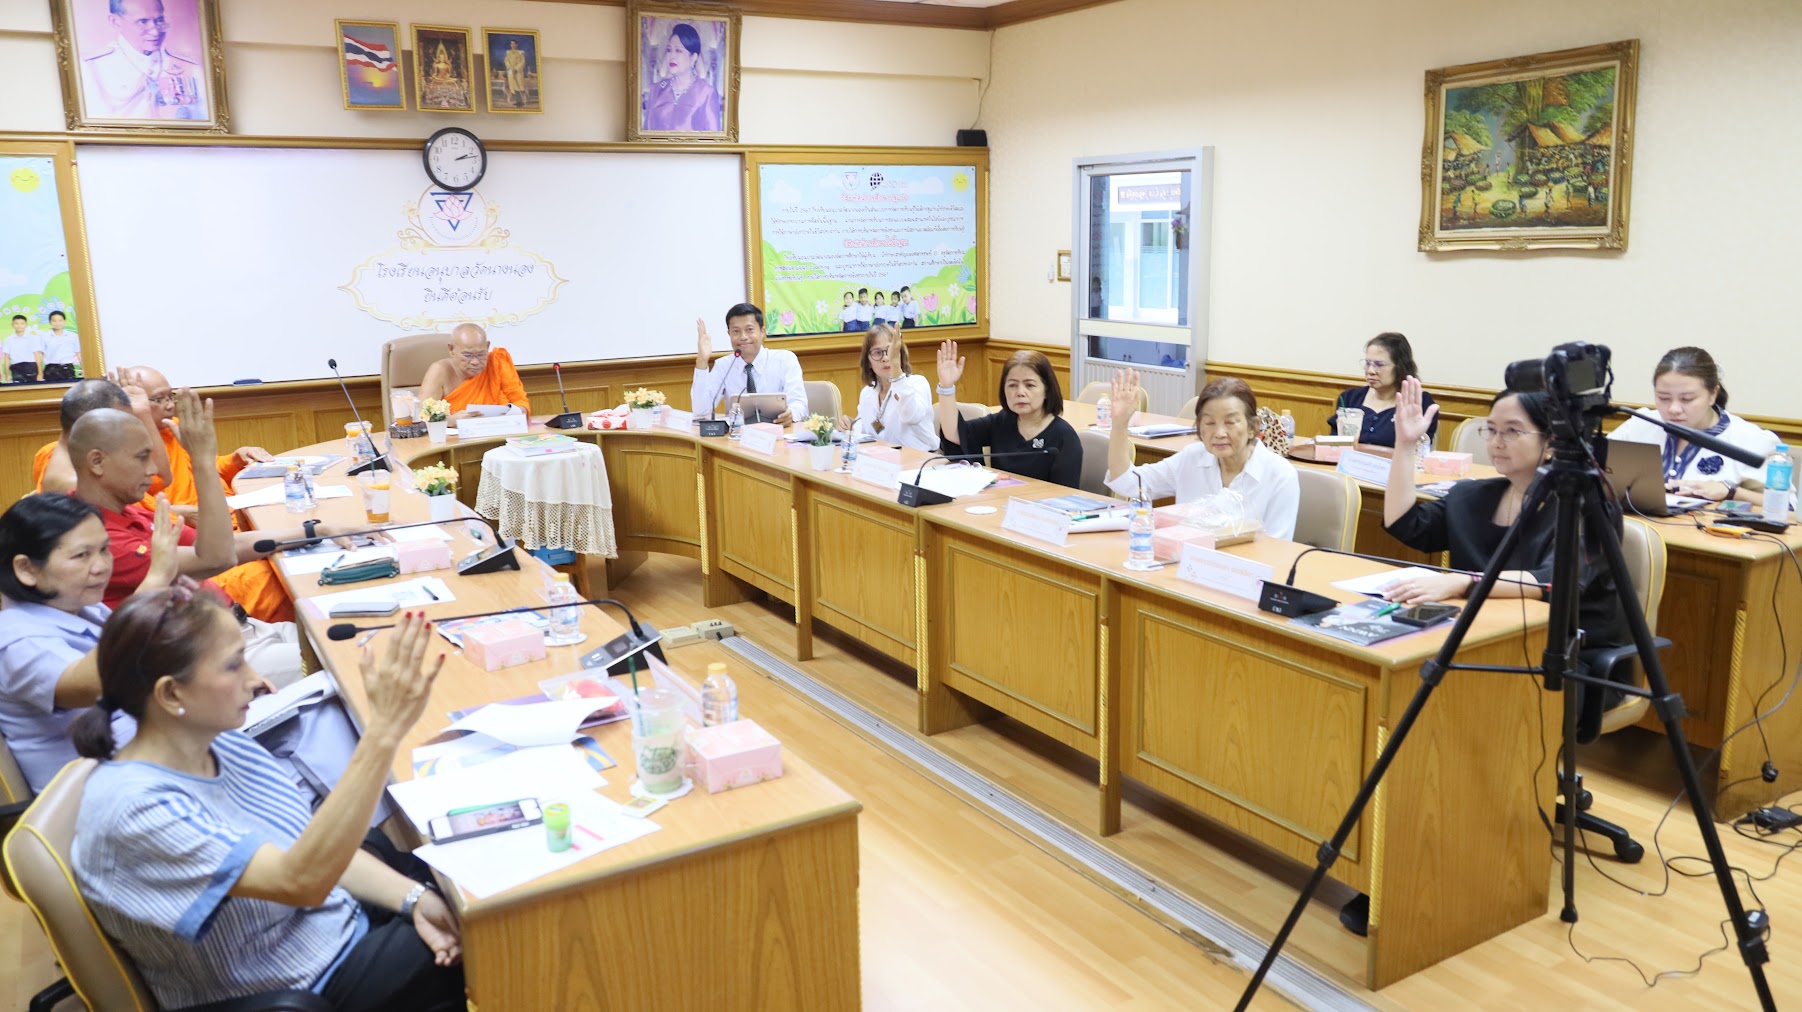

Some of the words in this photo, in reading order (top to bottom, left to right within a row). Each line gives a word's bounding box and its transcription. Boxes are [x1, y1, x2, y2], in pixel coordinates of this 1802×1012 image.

[450, 136, 459, 145] 12
[376, 261, 535, 284] โรงเรียนอนุบาลวัดนางนอง
[423, 286, 494, 304] ยินดีต้อนรับ
